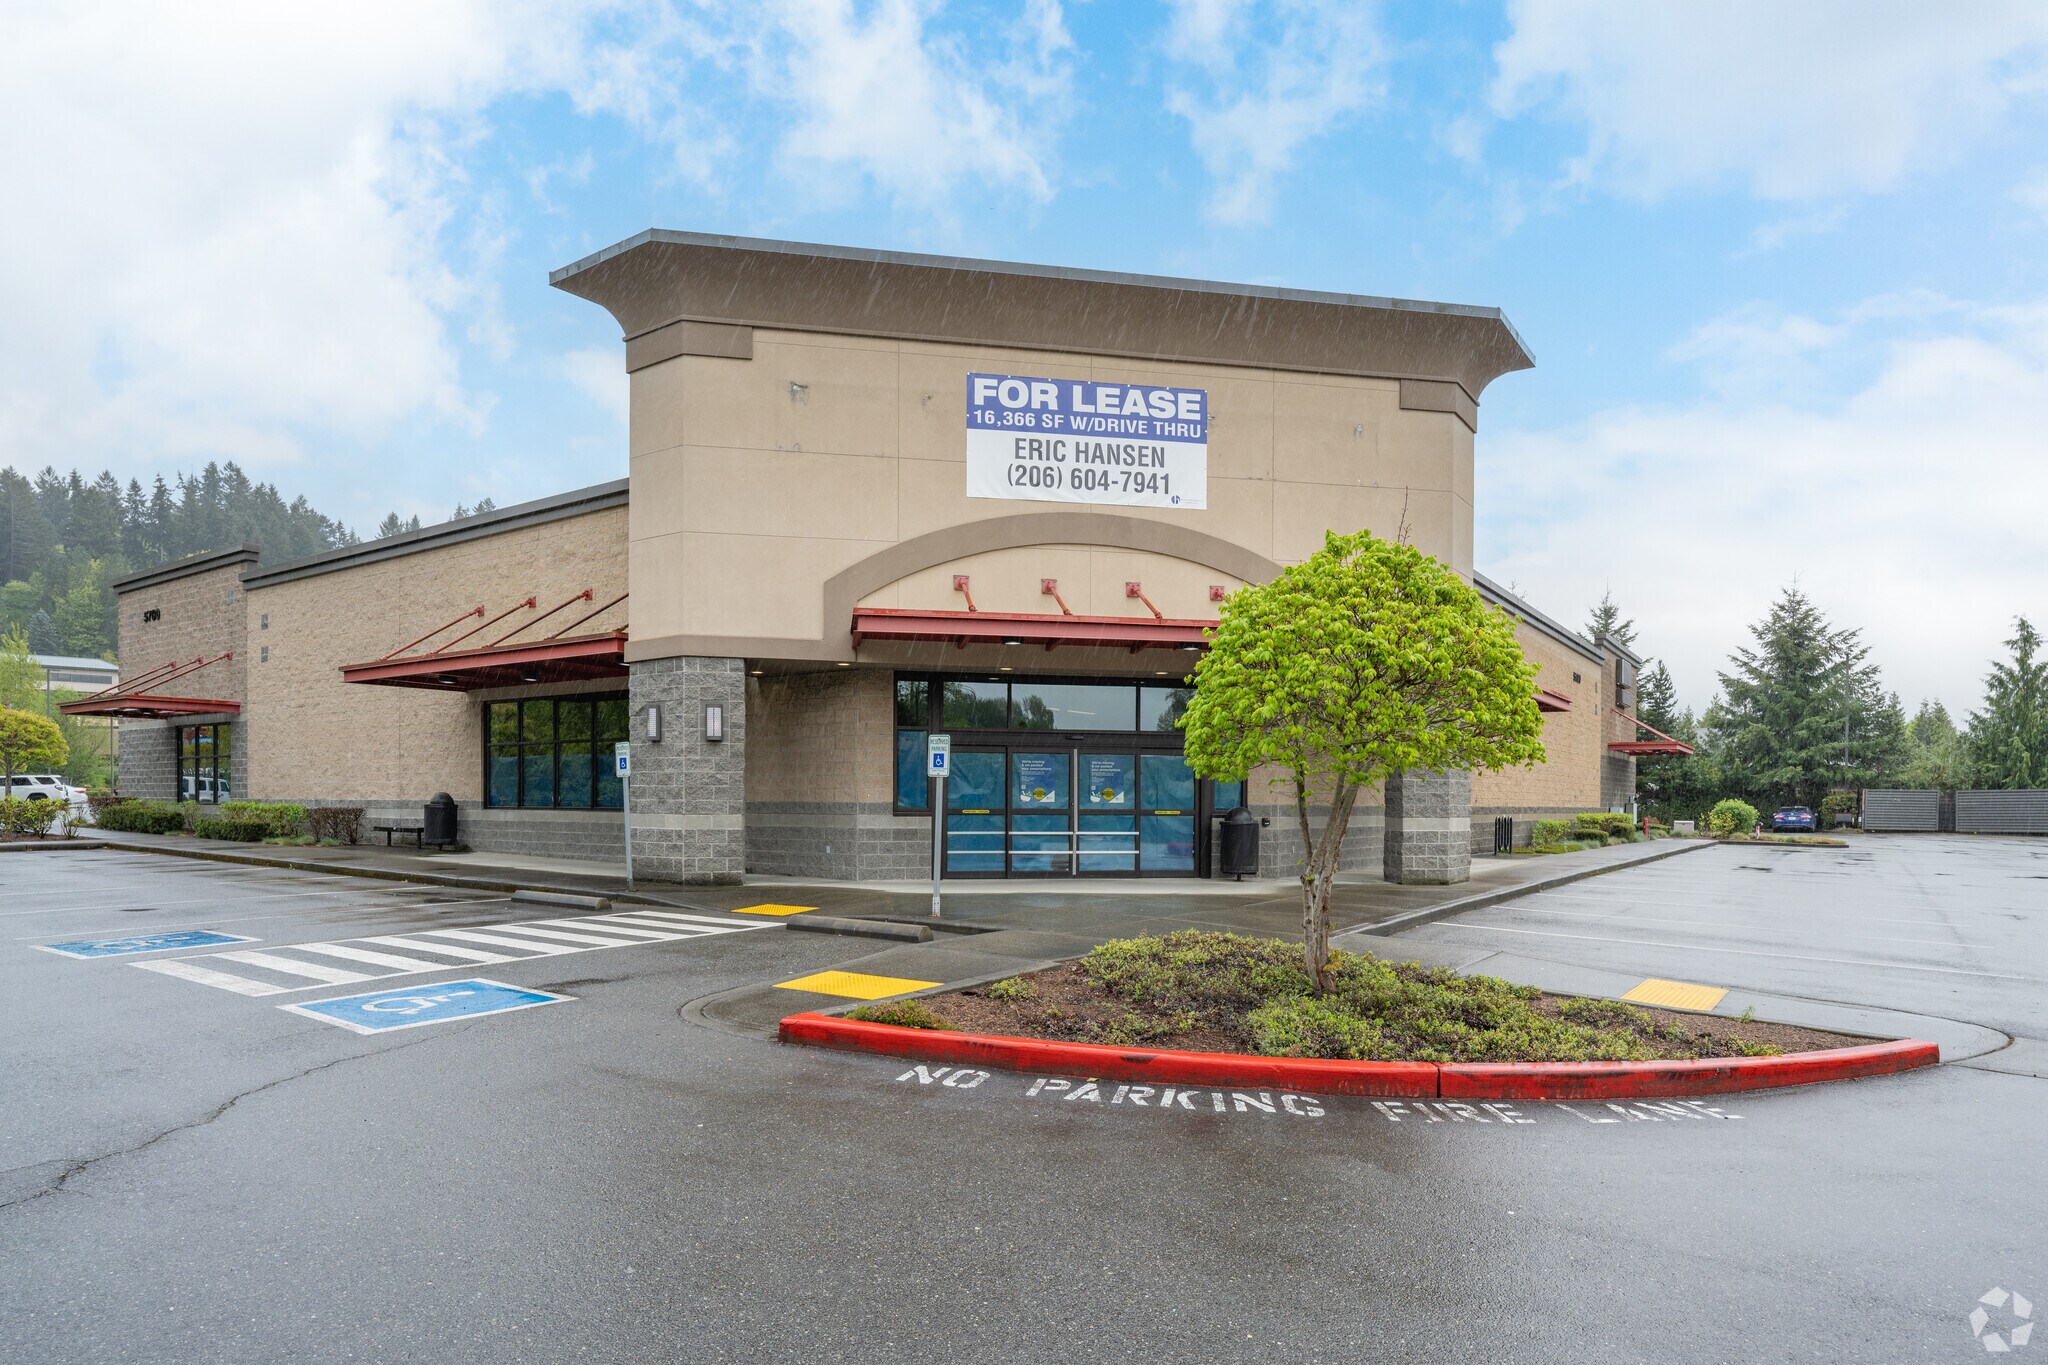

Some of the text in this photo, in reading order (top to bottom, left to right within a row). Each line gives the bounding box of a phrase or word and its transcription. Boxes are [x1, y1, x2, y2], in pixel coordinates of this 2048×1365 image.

[974, 377, 1201, 421] FOR LEASE
[973, 409, 1201, 439] 16,366 SF W/DRIVE THRU
[1014, 437, 1165, 468] ERIC HANSEN
[1007, 463, 1170, 495] (206) 604-7941
[896, 1065, 990, 1089] NO
[1025, 1077, 1325, 1117] PARKING
[1371, 1100, 1745, 1125] FIRE LANE
